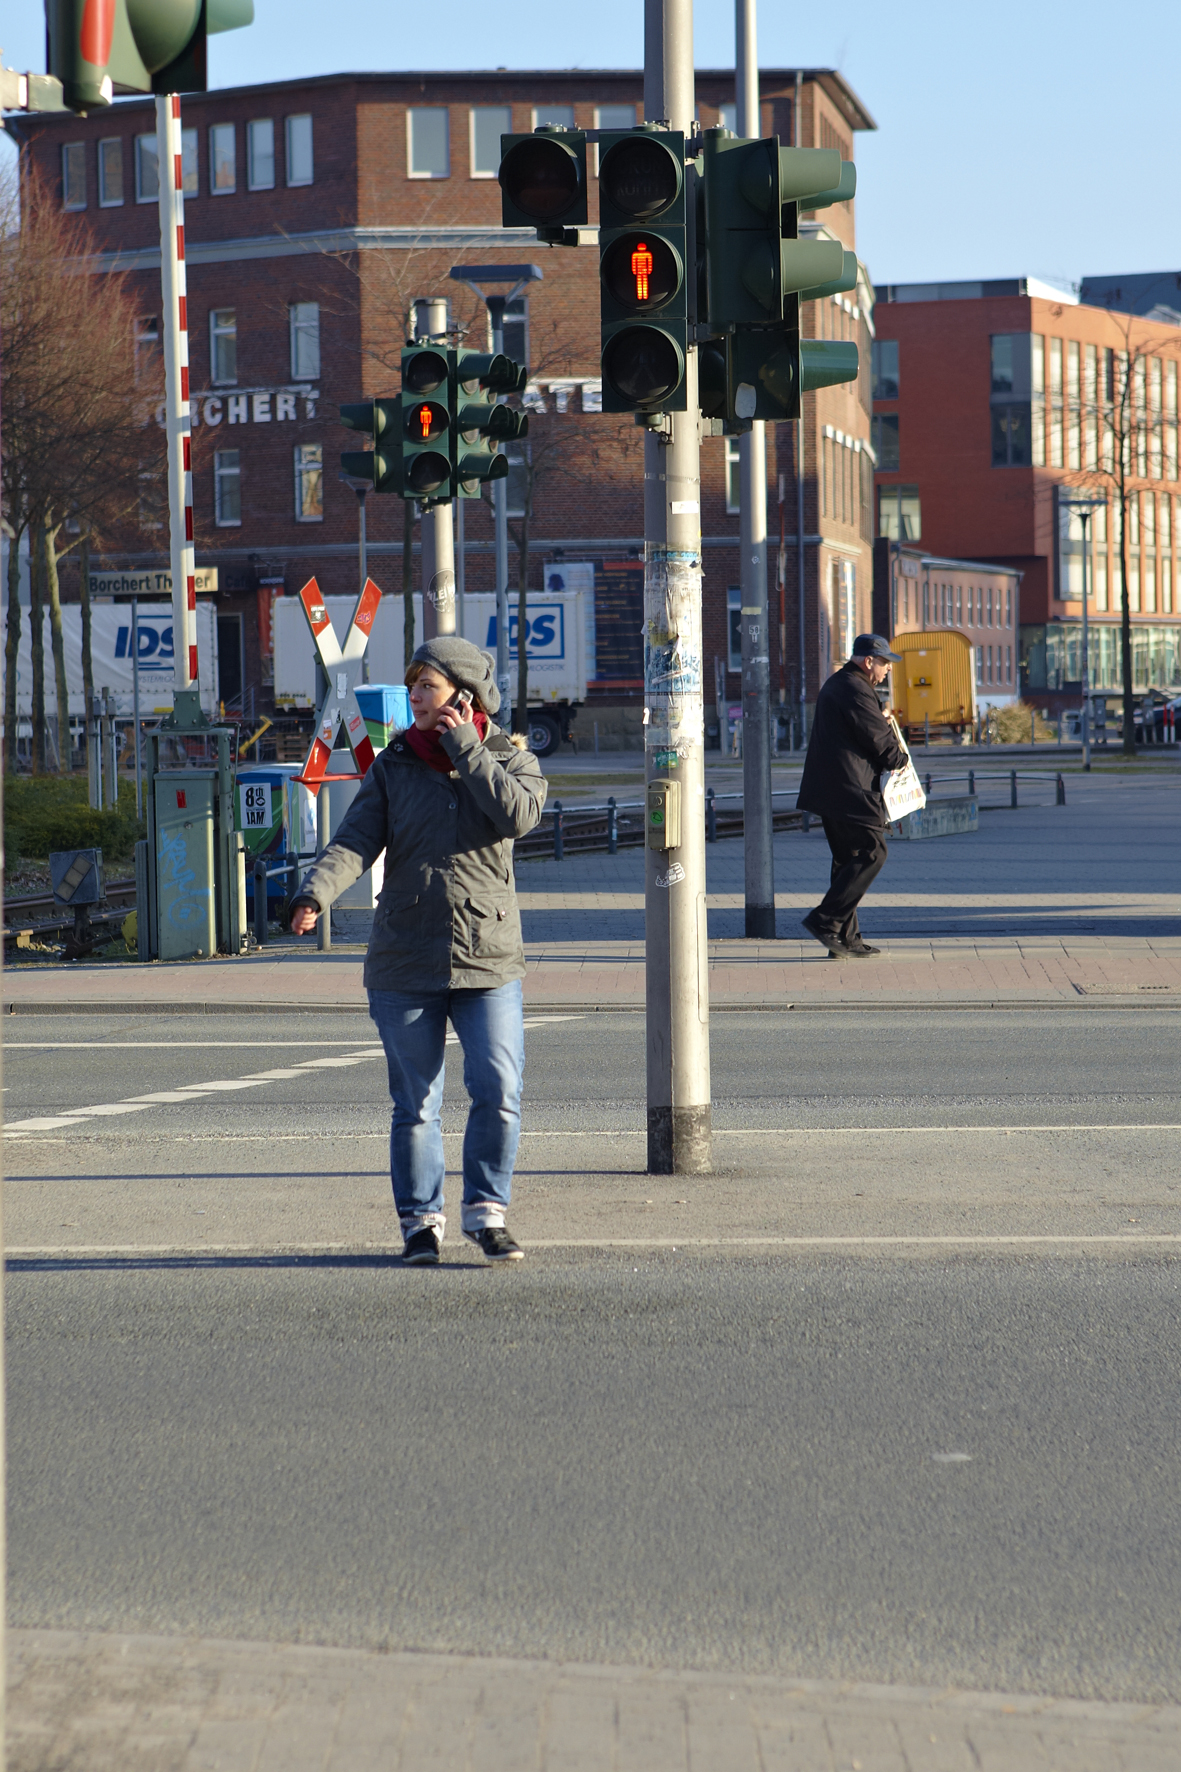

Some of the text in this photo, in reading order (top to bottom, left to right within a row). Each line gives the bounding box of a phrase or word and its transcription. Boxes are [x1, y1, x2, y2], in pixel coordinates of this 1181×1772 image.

[139, 389, 320, 429] OCHERT
[521, 384, 602, 413] ATE
[89, 574, 211, 592] Borchert Ther
[114, 626, 174, 658] IDS
[485, 614, 556, 648] IDS
